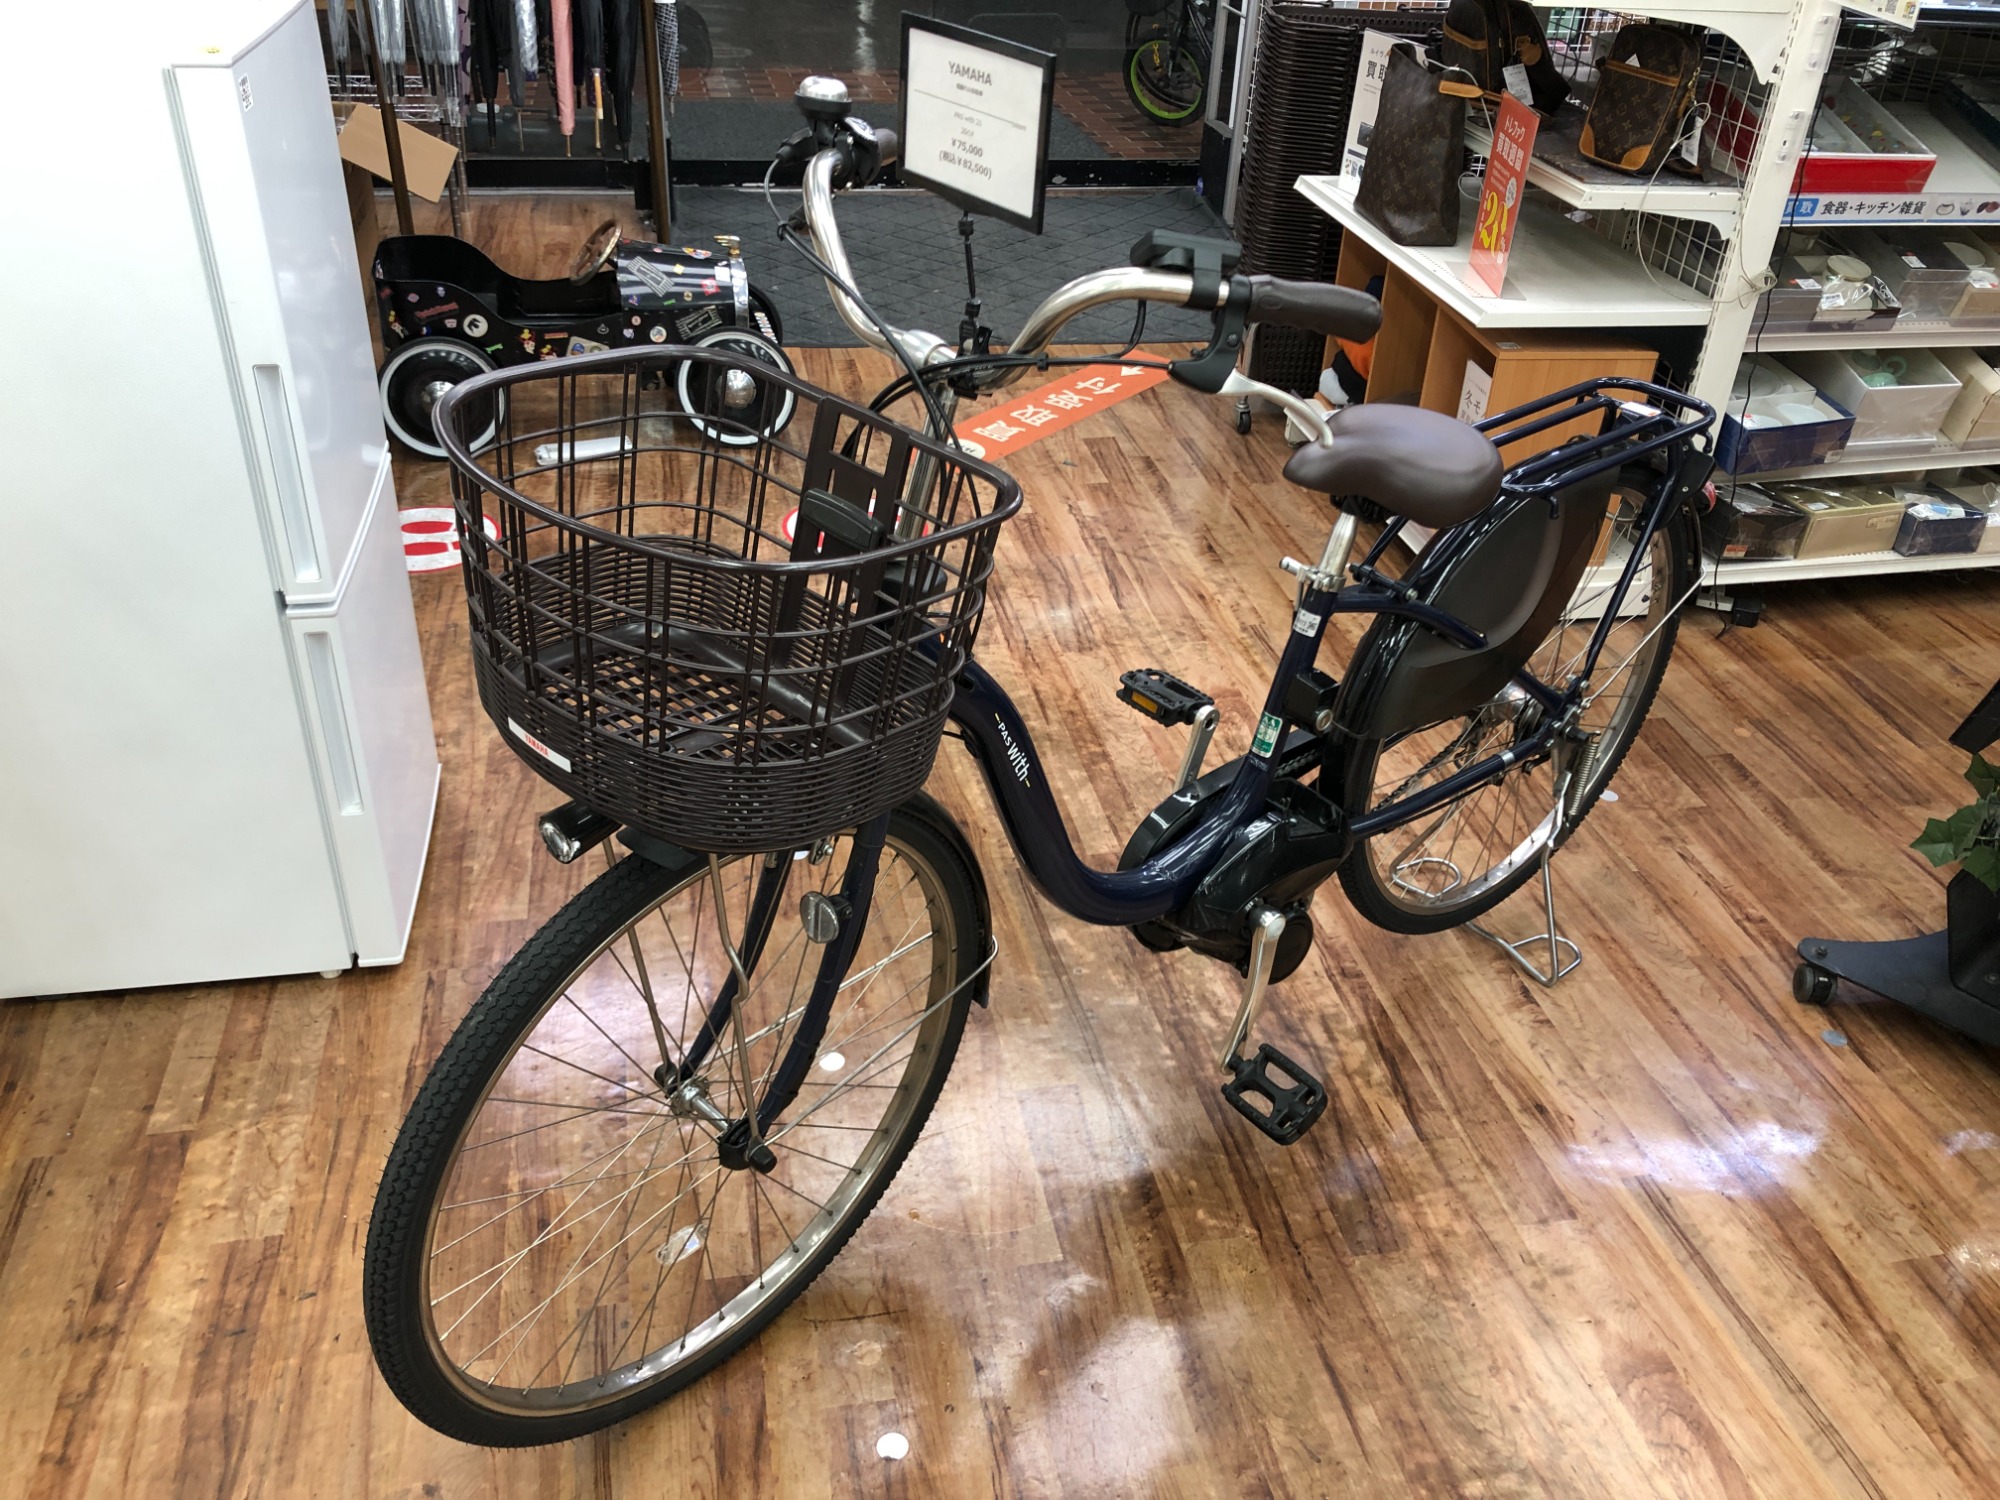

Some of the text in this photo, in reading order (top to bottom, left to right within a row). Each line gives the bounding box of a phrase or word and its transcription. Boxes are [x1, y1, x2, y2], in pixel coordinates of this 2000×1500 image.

[948, 61, 992, 86] YAMAHA
[1504, 114, 1525, 143] トレファク
[951, 137, 983, 158] ¥75,000
[1820, 200, 1928, 216] 食器・キッチン雑貨
[972, 376, 1123, 443] 買取受付
[998, 721, 1013, 747] PAS
